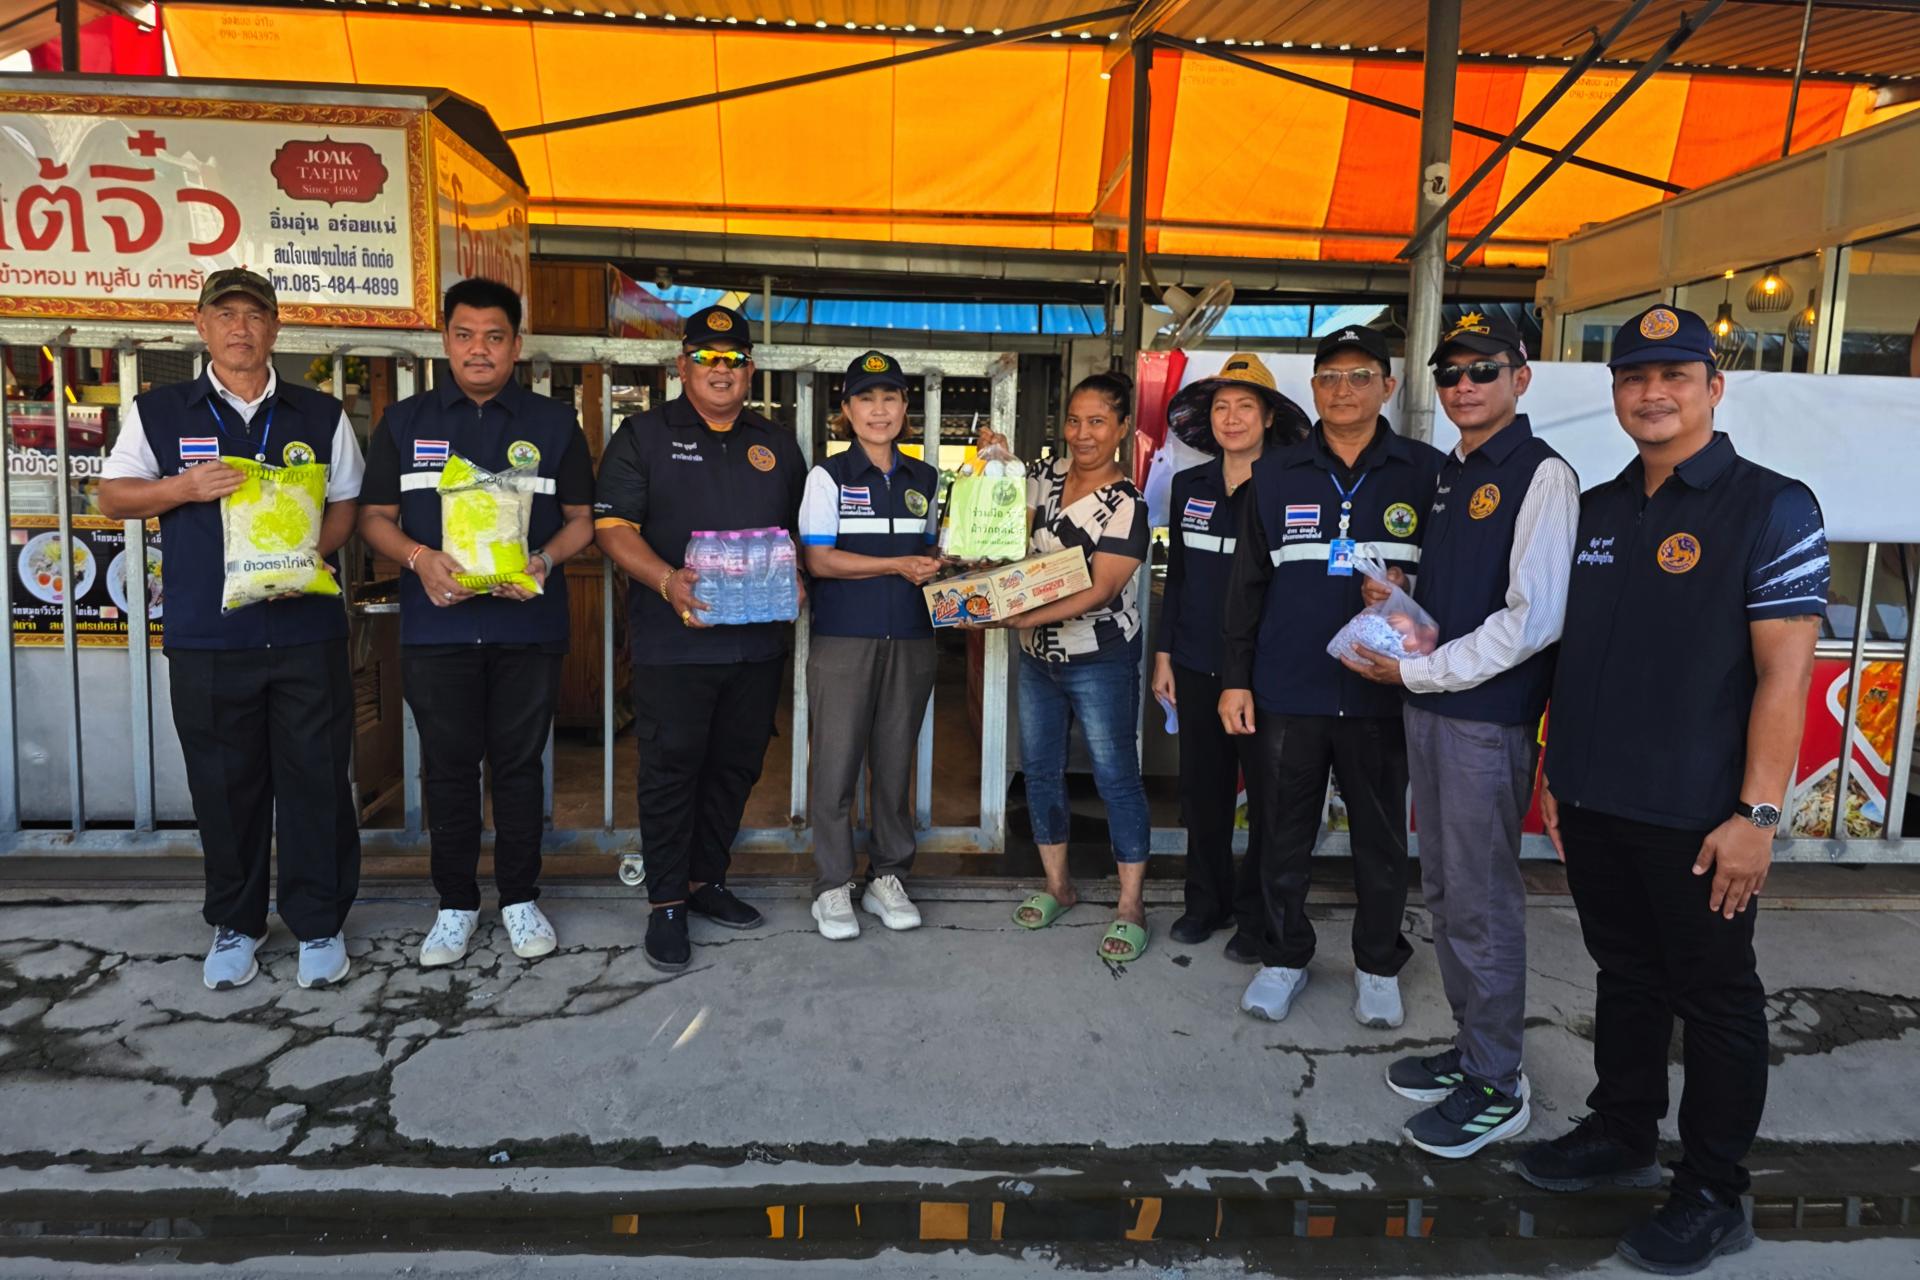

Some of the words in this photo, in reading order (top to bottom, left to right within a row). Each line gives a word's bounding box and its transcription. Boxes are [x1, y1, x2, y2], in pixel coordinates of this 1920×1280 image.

[304, 149, 353, 166] JOAK
[297, 166, 361, 185] TAEJIW
[302, 184, 330, 195] Since
[334, 185, 358, 196] 1969
[270, 206, 320, 237] อิ่มอุ่น
[328, 213, 397, 235] อร่อยแน่
[362, 247, 394, 269] ติดต่อ
[86, 266, 140, 293] หมูสับ
[148, 269, 204, 291] ตำหรั
